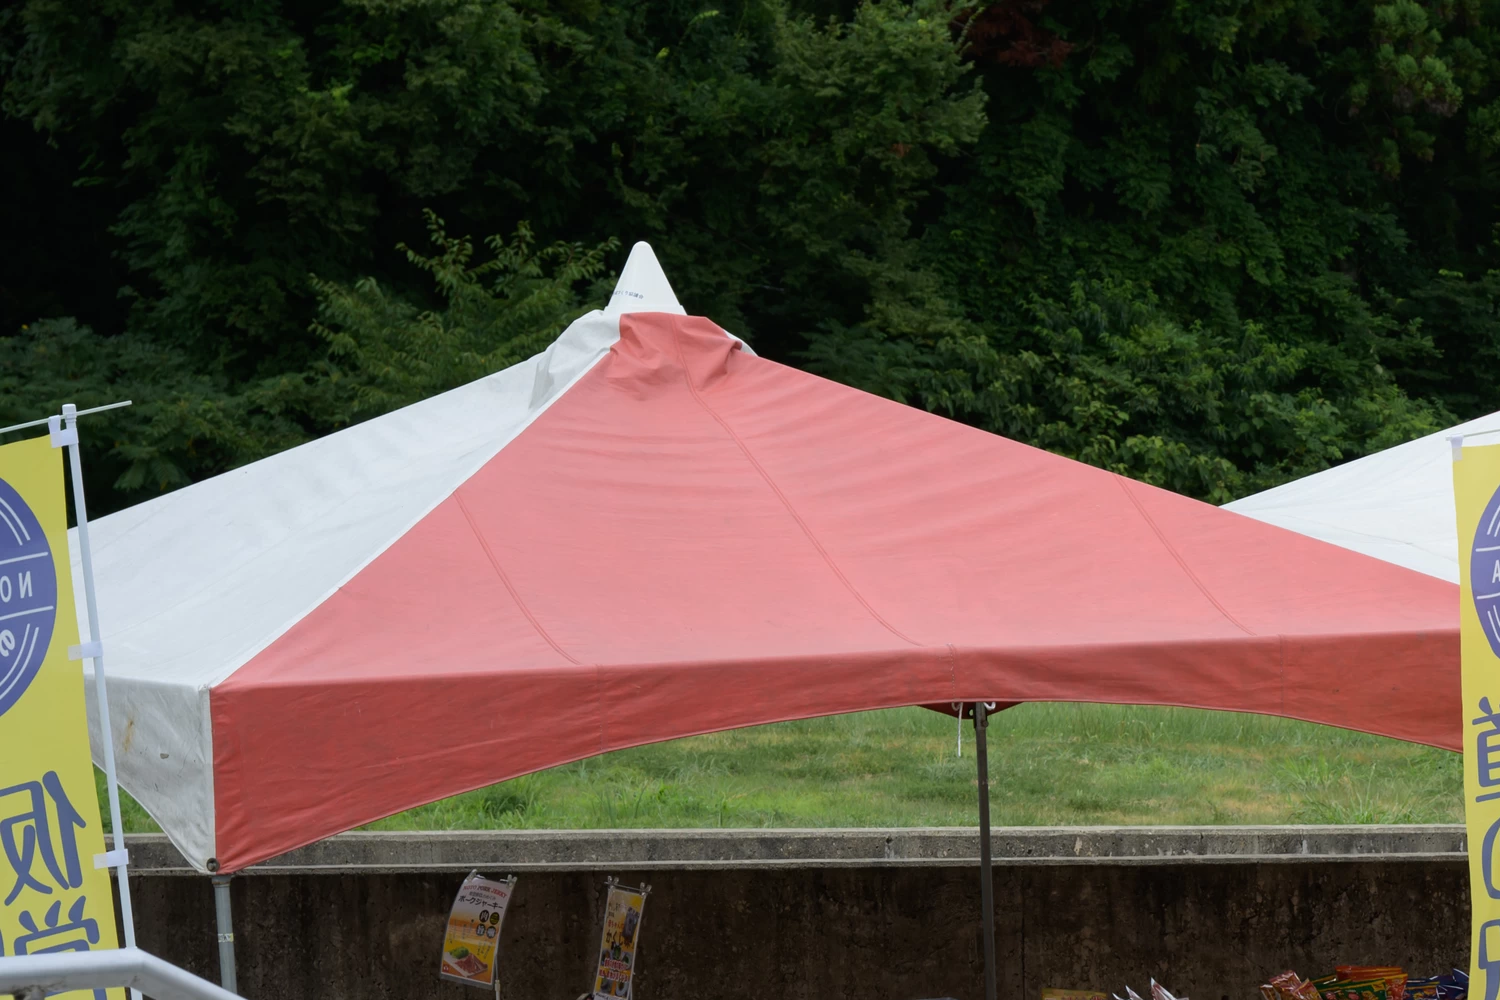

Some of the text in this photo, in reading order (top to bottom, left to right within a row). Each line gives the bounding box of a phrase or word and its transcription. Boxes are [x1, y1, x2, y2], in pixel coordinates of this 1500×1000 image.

[458, 895, 504, 910] ポークジャーキー
